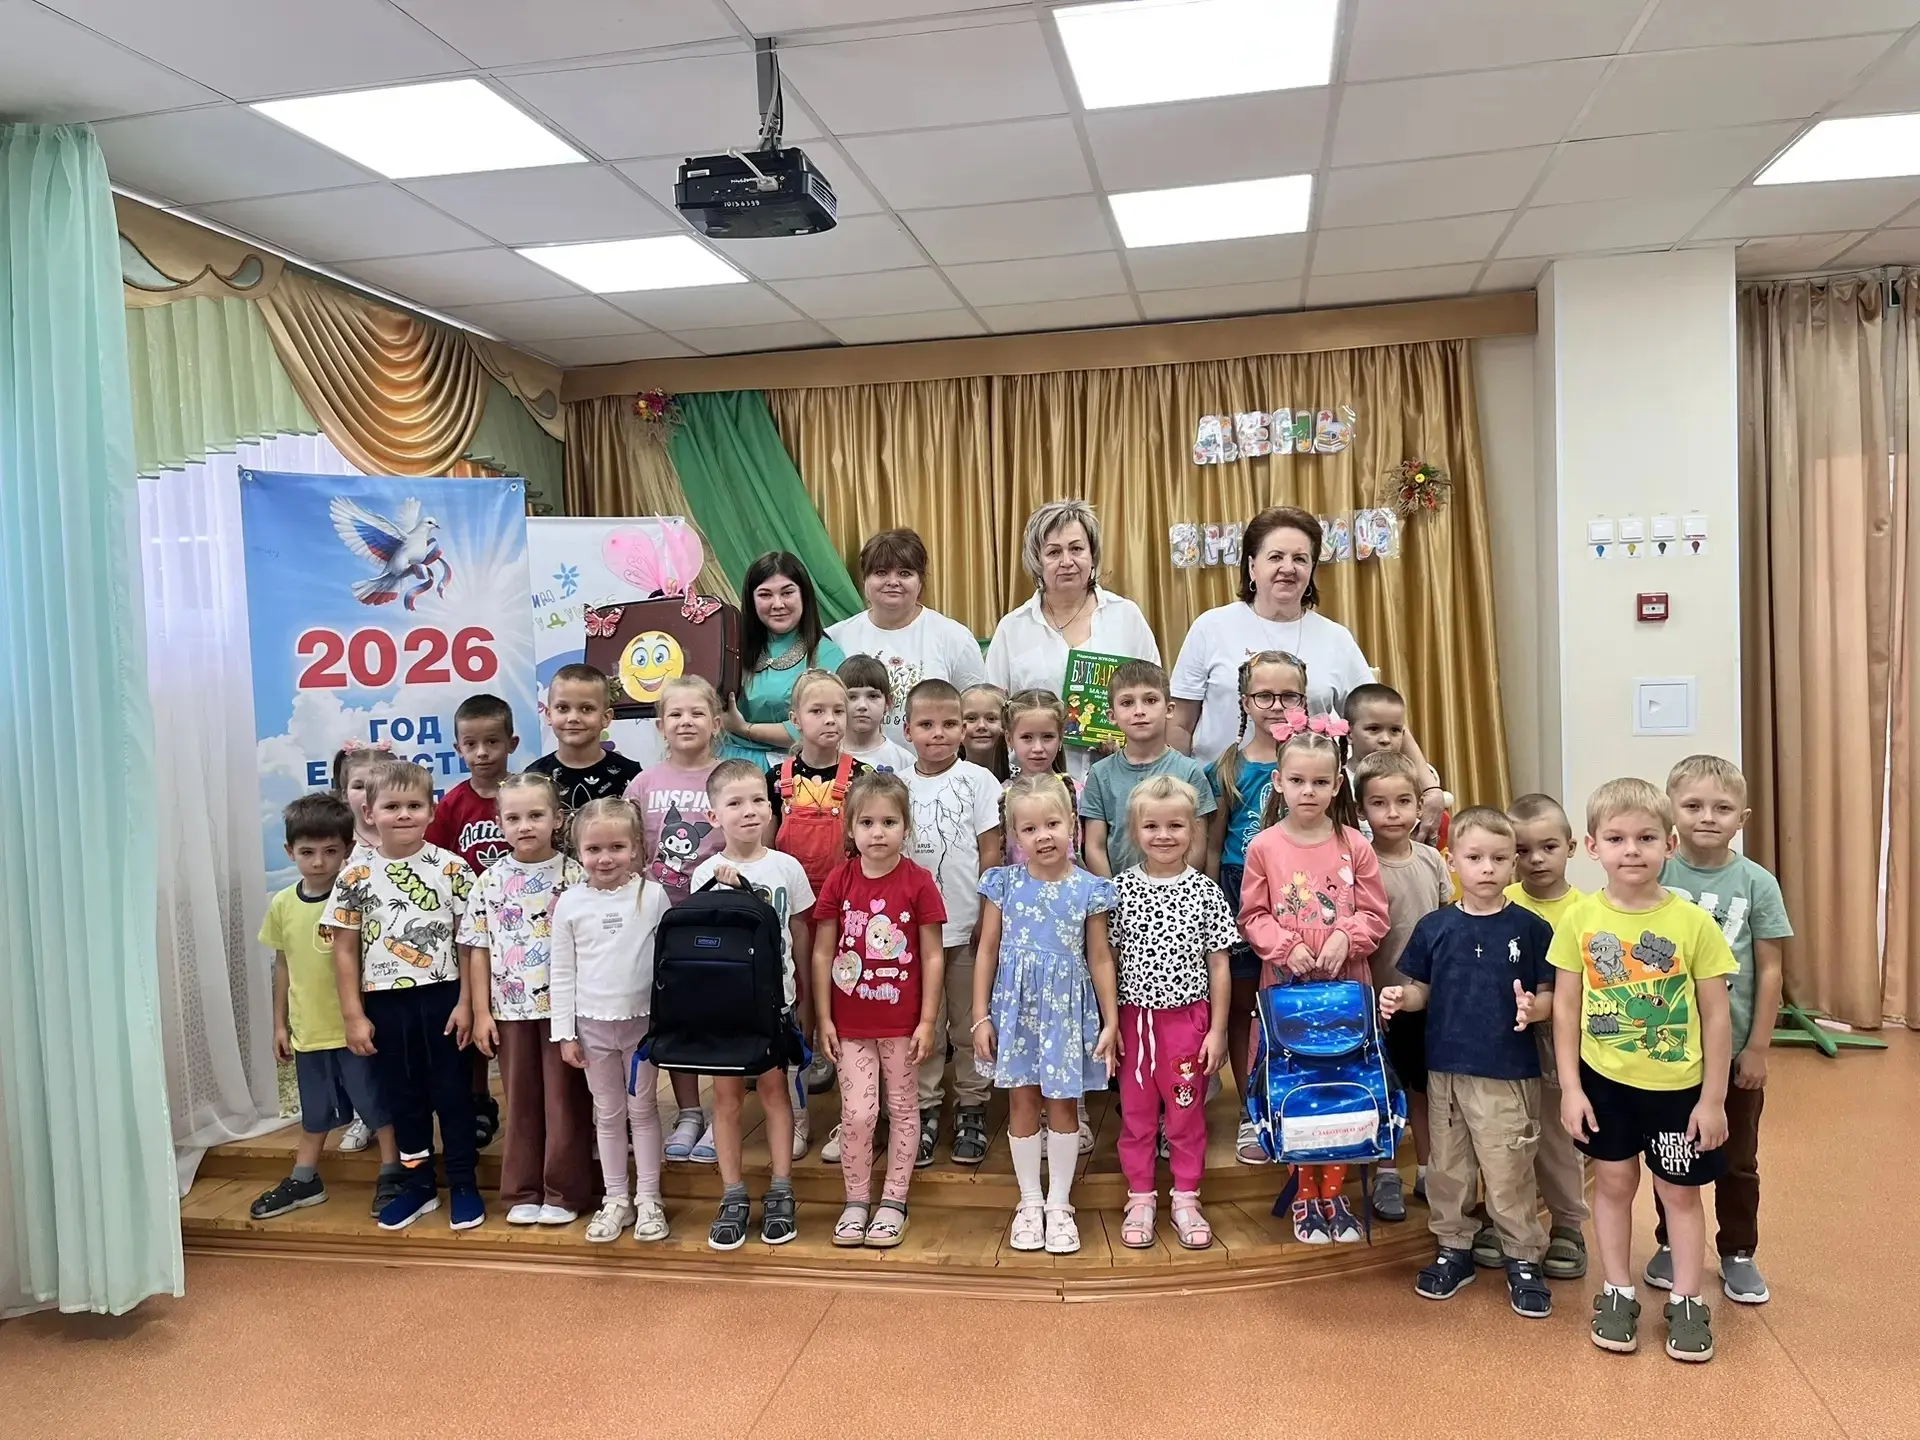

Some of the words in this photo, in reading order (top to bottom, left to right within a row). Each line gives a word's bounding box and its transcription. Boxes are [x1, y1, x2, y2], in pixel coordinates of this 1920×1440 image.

[1193, 407, 1352, 465] ДЕНЬ
[1170, 509, 1393, 566] ЗНИЙ
[298, 627, 498, 688] 2026
[1071, 660, 1118, 687] БУКВАР
[370, 716, 442, 745] ГОД
[1657, 1143, 1694, 1159] YORK
[1659, 1131, 1688, 1146] NEW
[1661, 1157, 1690, 1173] CITY
